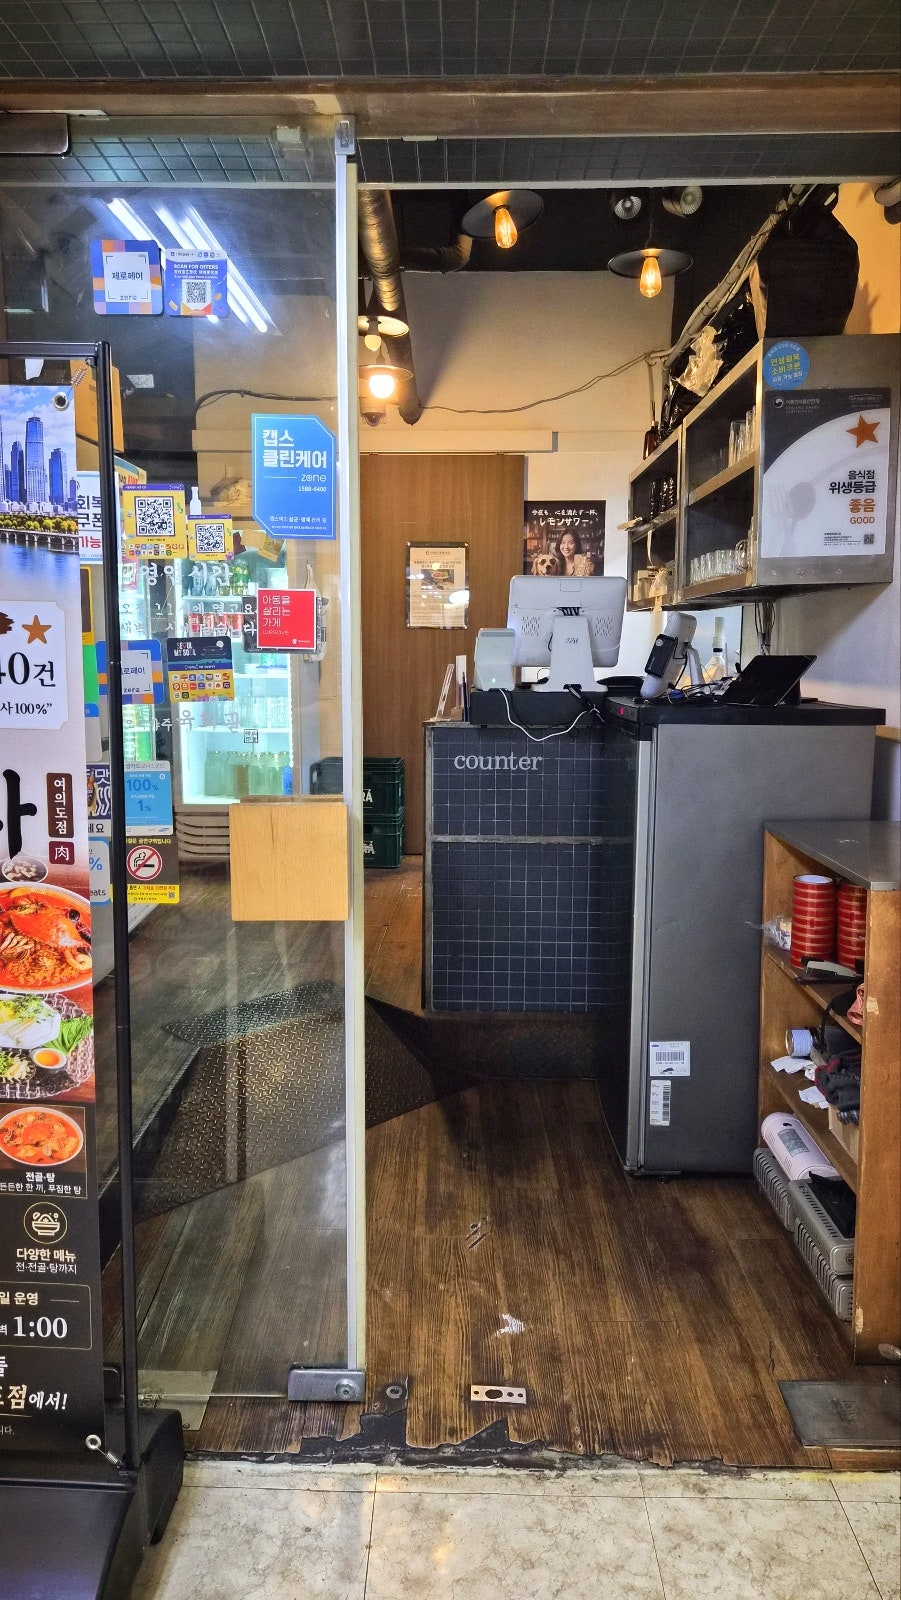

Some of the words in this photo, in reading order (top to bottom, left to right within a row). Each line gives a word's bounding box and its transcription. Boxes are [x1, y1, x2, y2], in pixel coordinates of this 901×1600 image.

[111, 271, 143, 281] 제로페이
[262, 429, 295, 447] 캡스
[262, 449, 327, 469] 클린케어
[848, 469, 875, 480] 음식점
[828, 480, 877, 495] 위생등급
[849, 498, 876, 513] 좋음
[539, 517, 590, 526] レモンサワー
[849, 516, 875, 525] GOOD
[79, 535, 102, 549] 가능
[262, 595, 291, 605] 아동을
[262, 606, 291, 617] 살리는
[262, 617, 281, 628] 가게
[122, 666, 145, 675] 로페이
[453, 752, 543, 771] counter
[127, 779, 159, 791] 100%
[54, 777, 68, 835] 여의도점
[138, 799, 152, 812] 1%
[54, 846, 70, 861] 肉
[25, 1171, 56, 1183] 전골·탕
[25, 1183, 34, 1192] 한
[47, 1184, 72, 1195] 푸짐한
[73, 1185, 82, 1195] 탕
[16, 1248, 51, 1262] 다양한
[53, 1249, 77, 1264] 메뉴
[13, 1291, 39, 1306] 운영
[13, 1316, 68, 1339] 1:00
